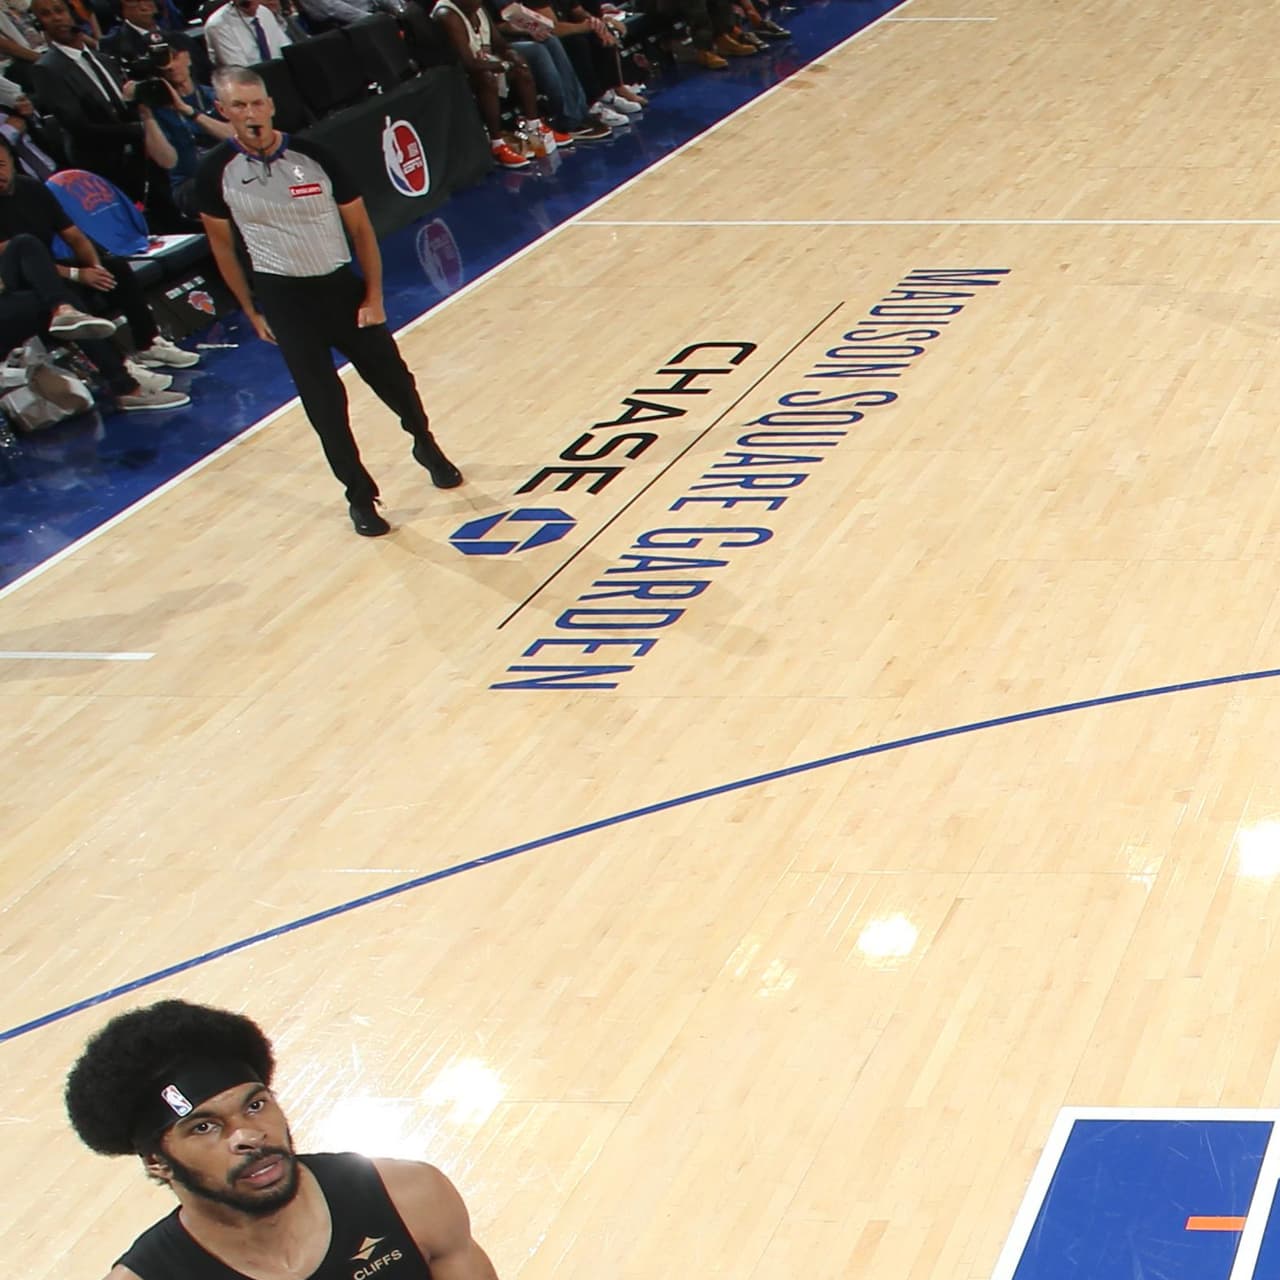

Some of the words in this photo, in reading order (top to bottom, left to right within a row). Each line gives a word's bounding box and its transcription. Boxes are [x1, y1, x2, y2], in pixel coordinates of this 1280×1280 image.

[803, 268, 1012, 379] MADISON
[514, 341, 758, 495] CHASE
[668, 390, 899, 511] SQUARE
[488, 526, 774, 690] GARDEN
